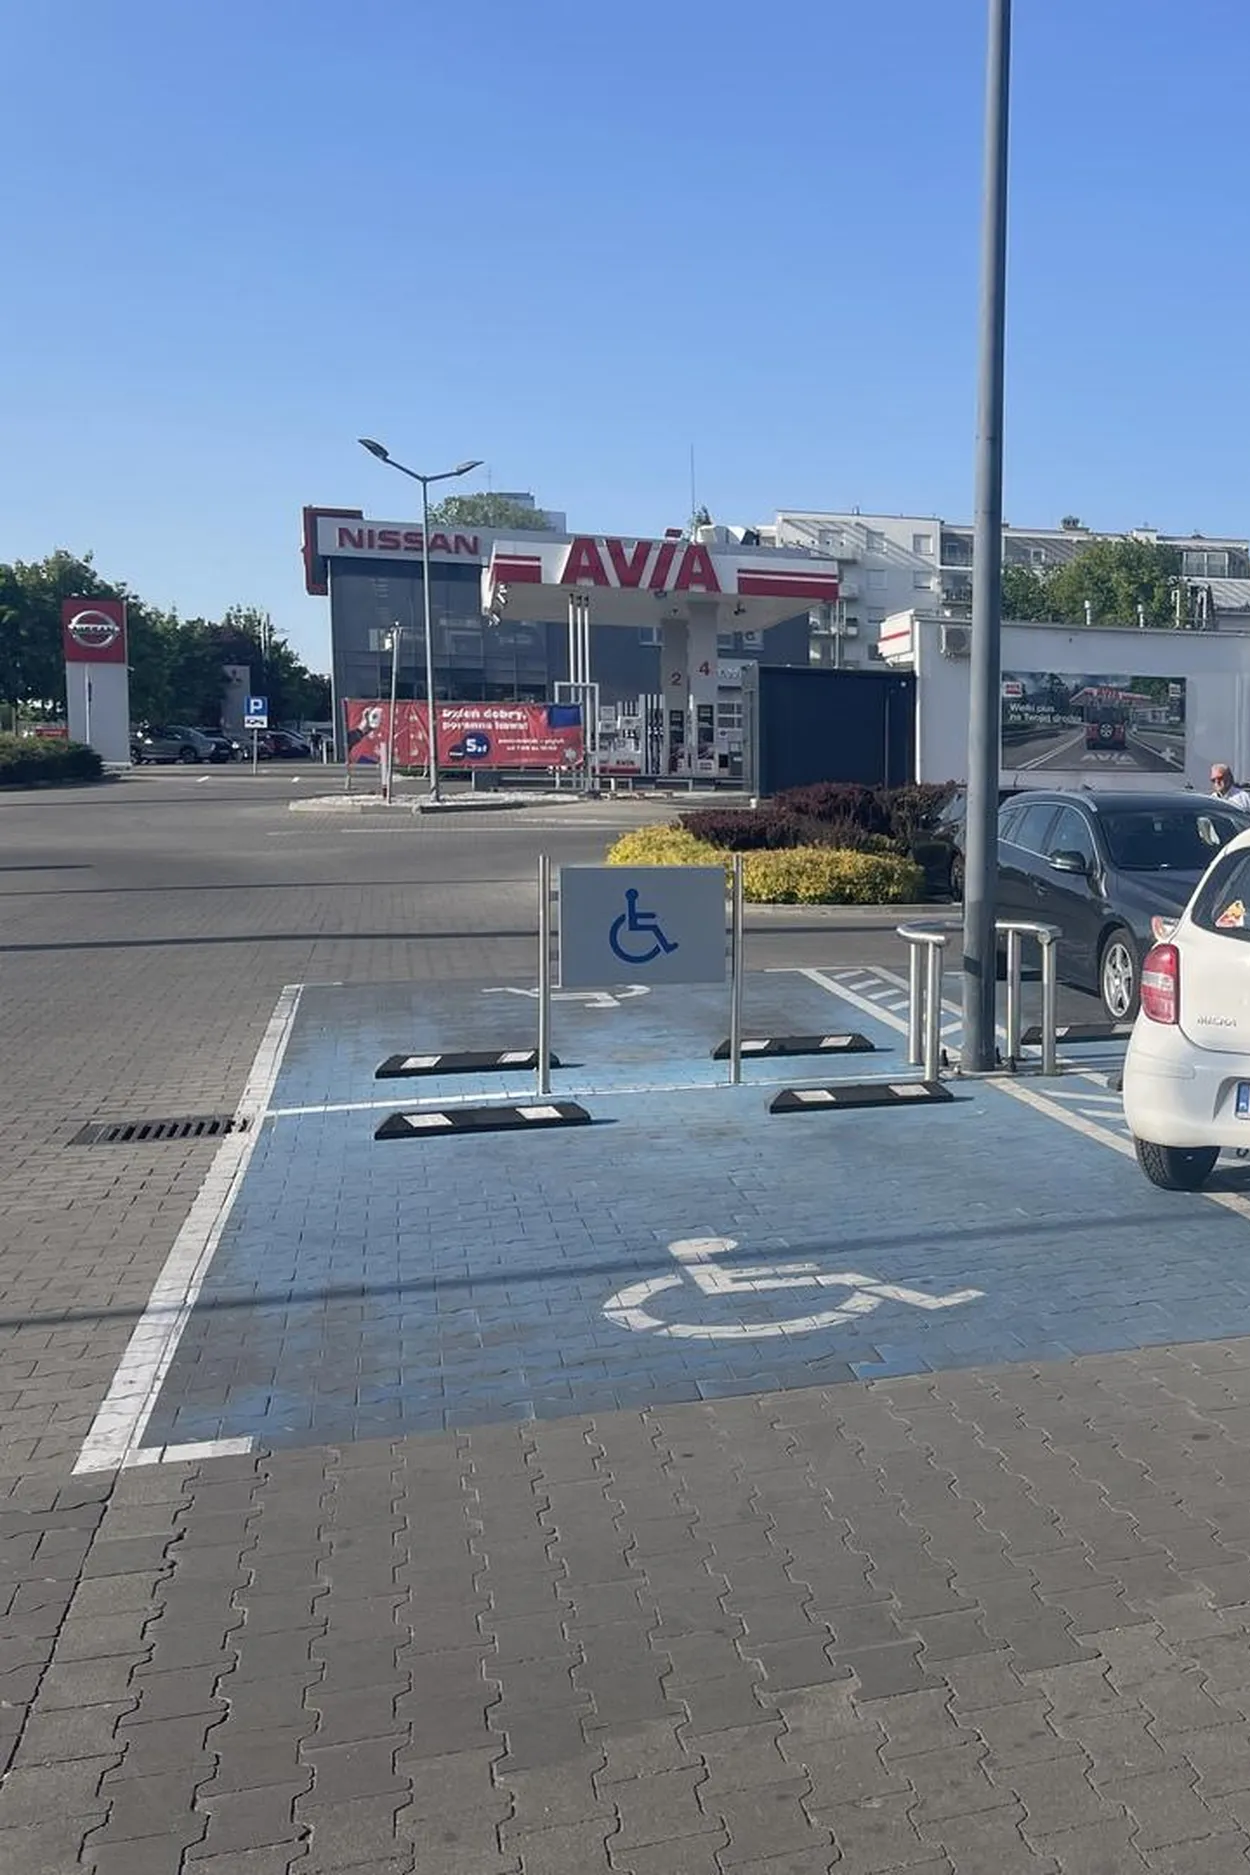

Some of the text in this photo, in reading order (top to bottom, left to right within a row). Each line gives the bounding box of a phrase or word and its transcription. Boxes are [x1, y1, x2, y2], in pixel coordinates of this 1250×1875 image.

[338, 527, 480, 555] NISSAN
[560, 529, 722, 593] AVIA
[699, 662, 710, 676] 4
[671, 673, 681, 686] 2
[250, 699, 263, 714] P
